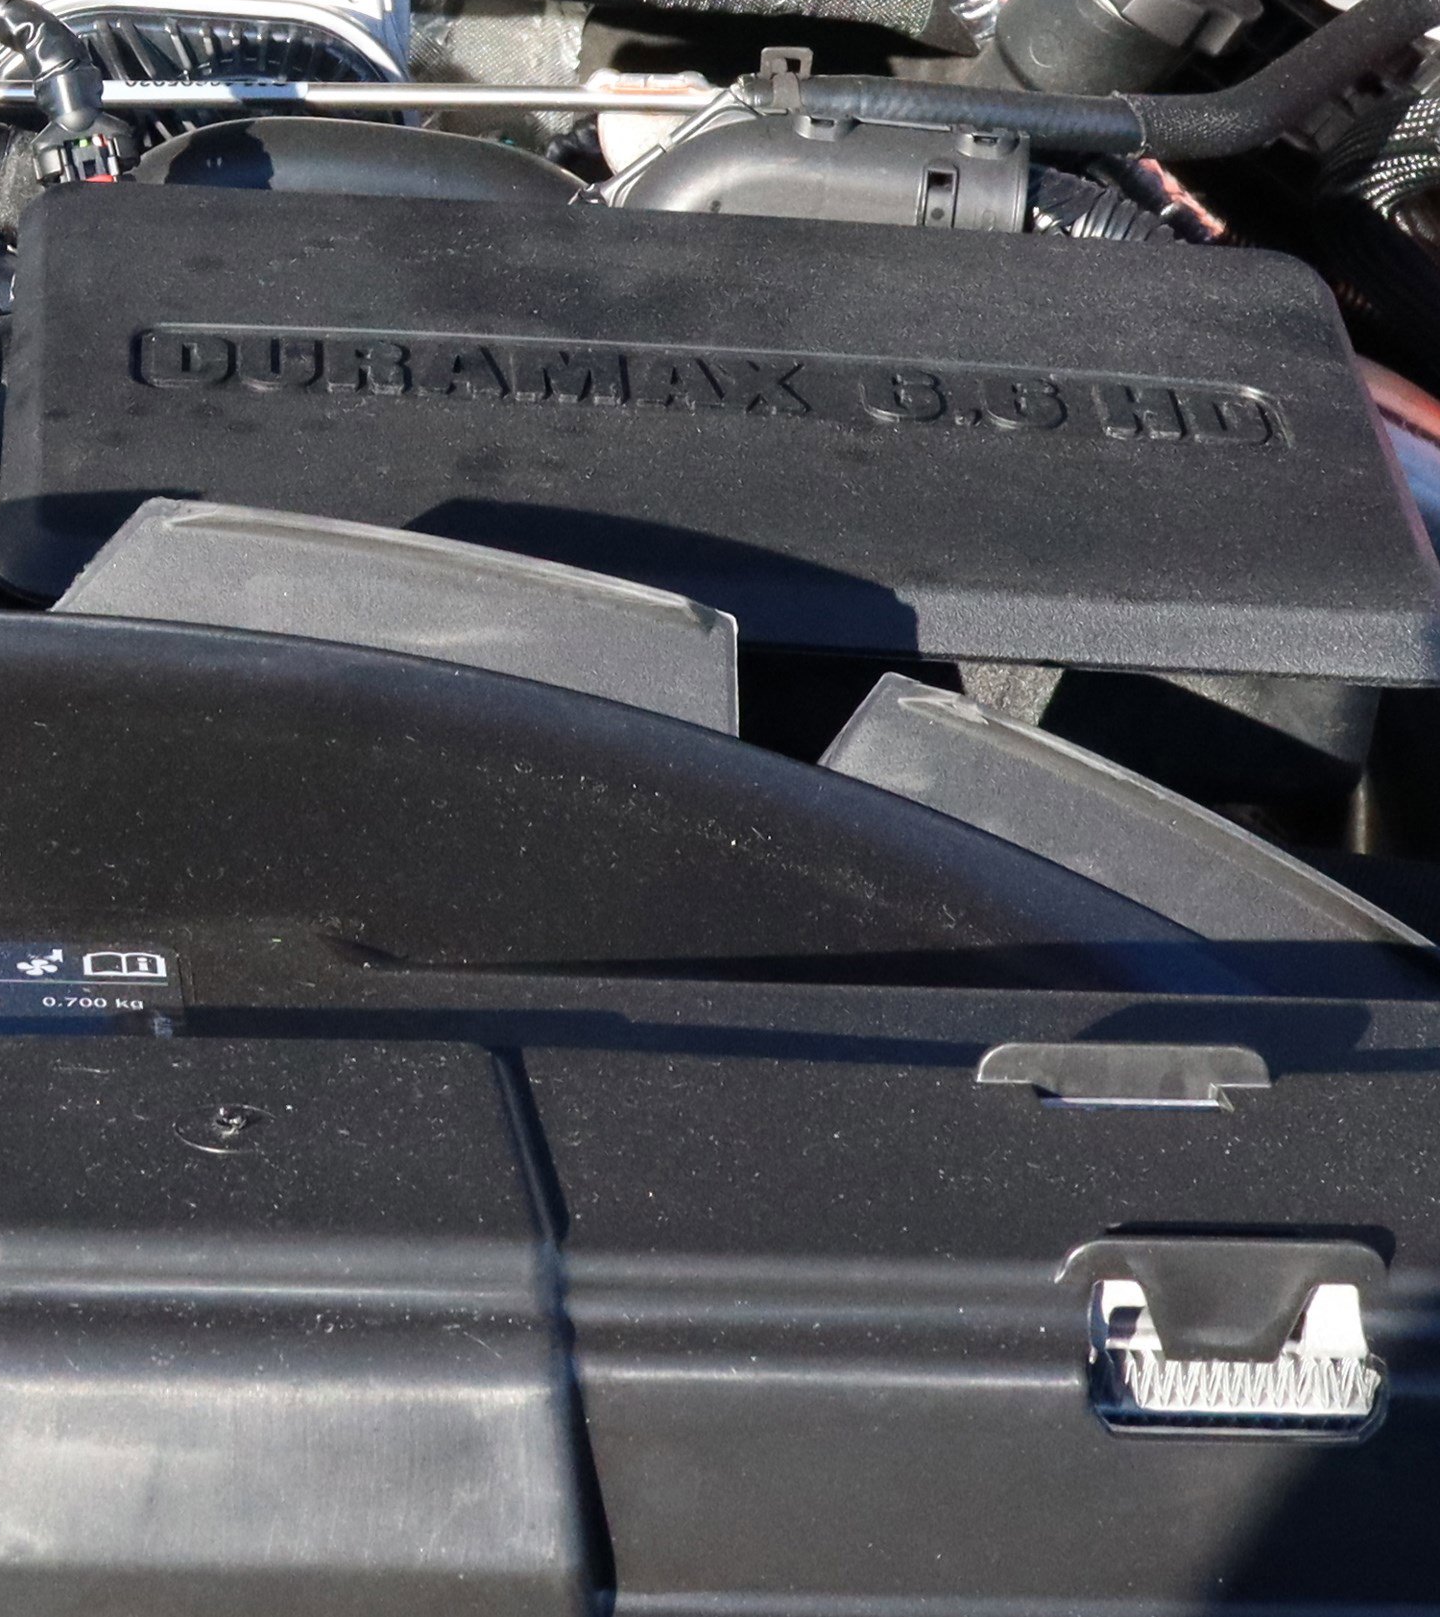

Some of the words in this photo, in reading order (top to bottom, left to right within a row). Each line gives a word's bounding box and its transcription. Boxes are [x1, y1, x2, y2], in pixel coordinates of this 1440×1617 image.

[130, 327, 812, 414] DURAMAX
[1094, 382, 1290, 446] HD
[42, 996, 107, 1008] 0.700
[115, 997, 144, 1010] kg
